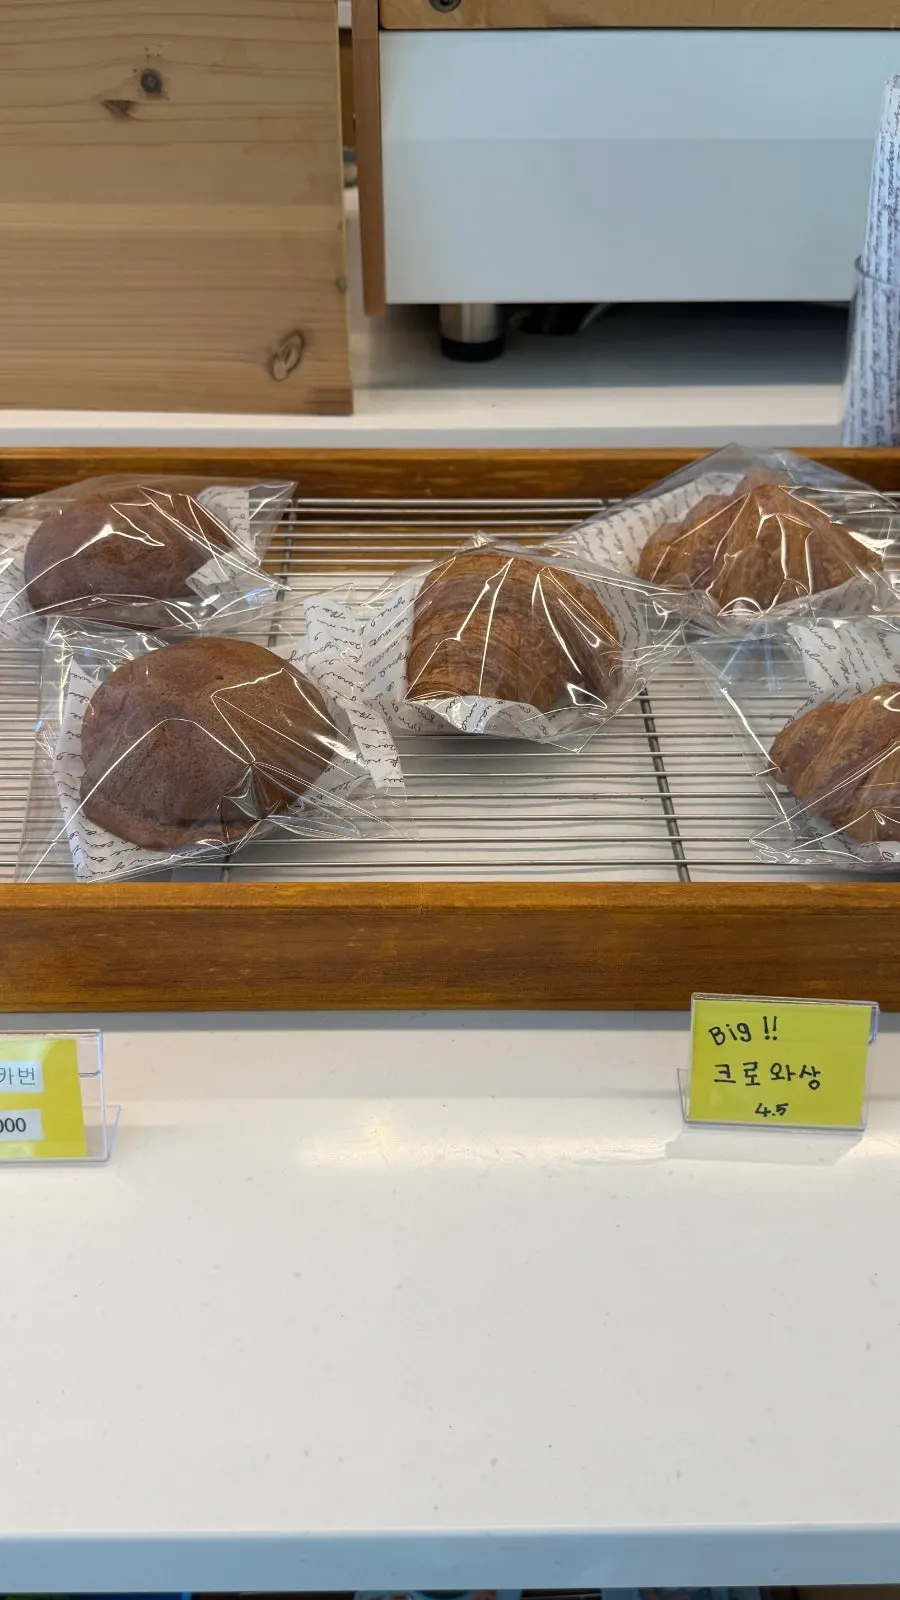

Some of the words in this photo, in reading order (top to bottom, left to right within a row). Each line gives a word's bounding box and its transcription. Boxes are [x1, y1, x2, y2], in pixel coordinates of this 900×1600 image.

[708, 1022, 752, 1046] Big
[762, 1015, 778, 1041] !!
[754, 1102, 789, 1118] 4.5
